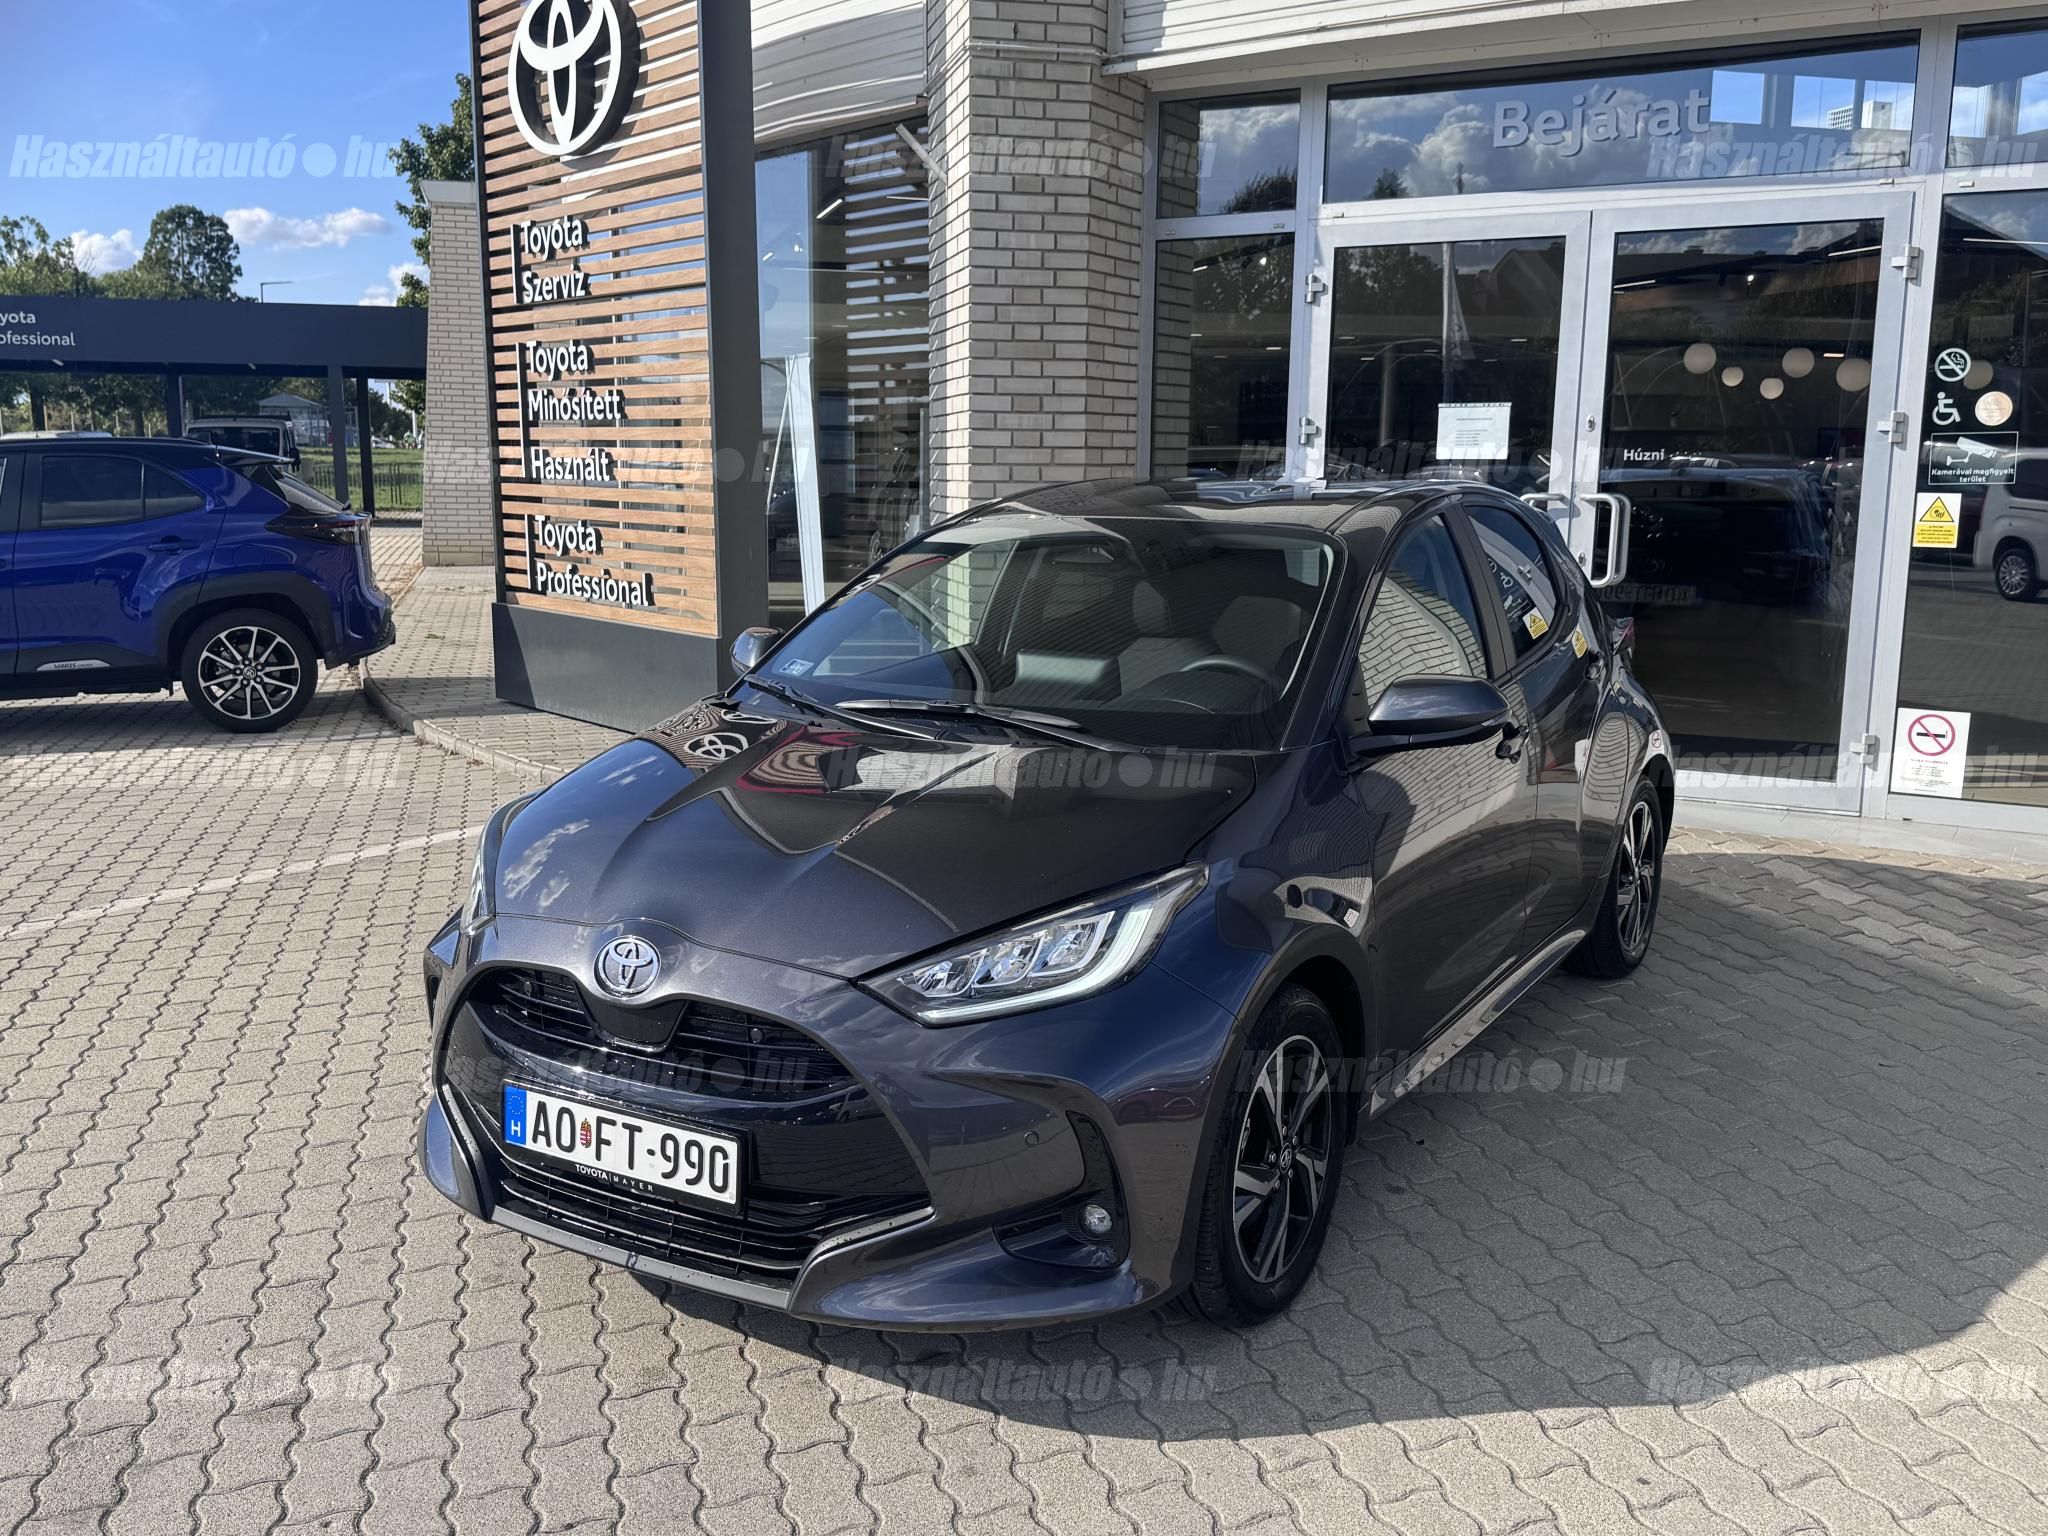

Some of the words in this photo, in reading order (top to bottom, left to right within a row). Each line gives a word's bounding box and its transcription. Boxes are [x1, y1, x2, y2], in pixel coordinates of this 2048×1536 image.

[1493, 88, 1710, 157] Bejárat
[521, 215, 583, 261] Toyota
[522, 264, 586, 303] Szerviz
[527, 340, 589, 382] Toyota
[528, 388, 621, 421] Minősített
[531, 448, 610, 481] Használt
[1623, 448, 1665, 461] Húzni
[1973, 468, 2014, 476] megfigyelt
[535, 515, 597, 557] Toyota
[537, 562, 649, 607] Professional
[510, 1120, 521, 1138] H
[575, 1163, 608, 1181] TOYOTA
[613, 1175, 654, 1192] MAYER
